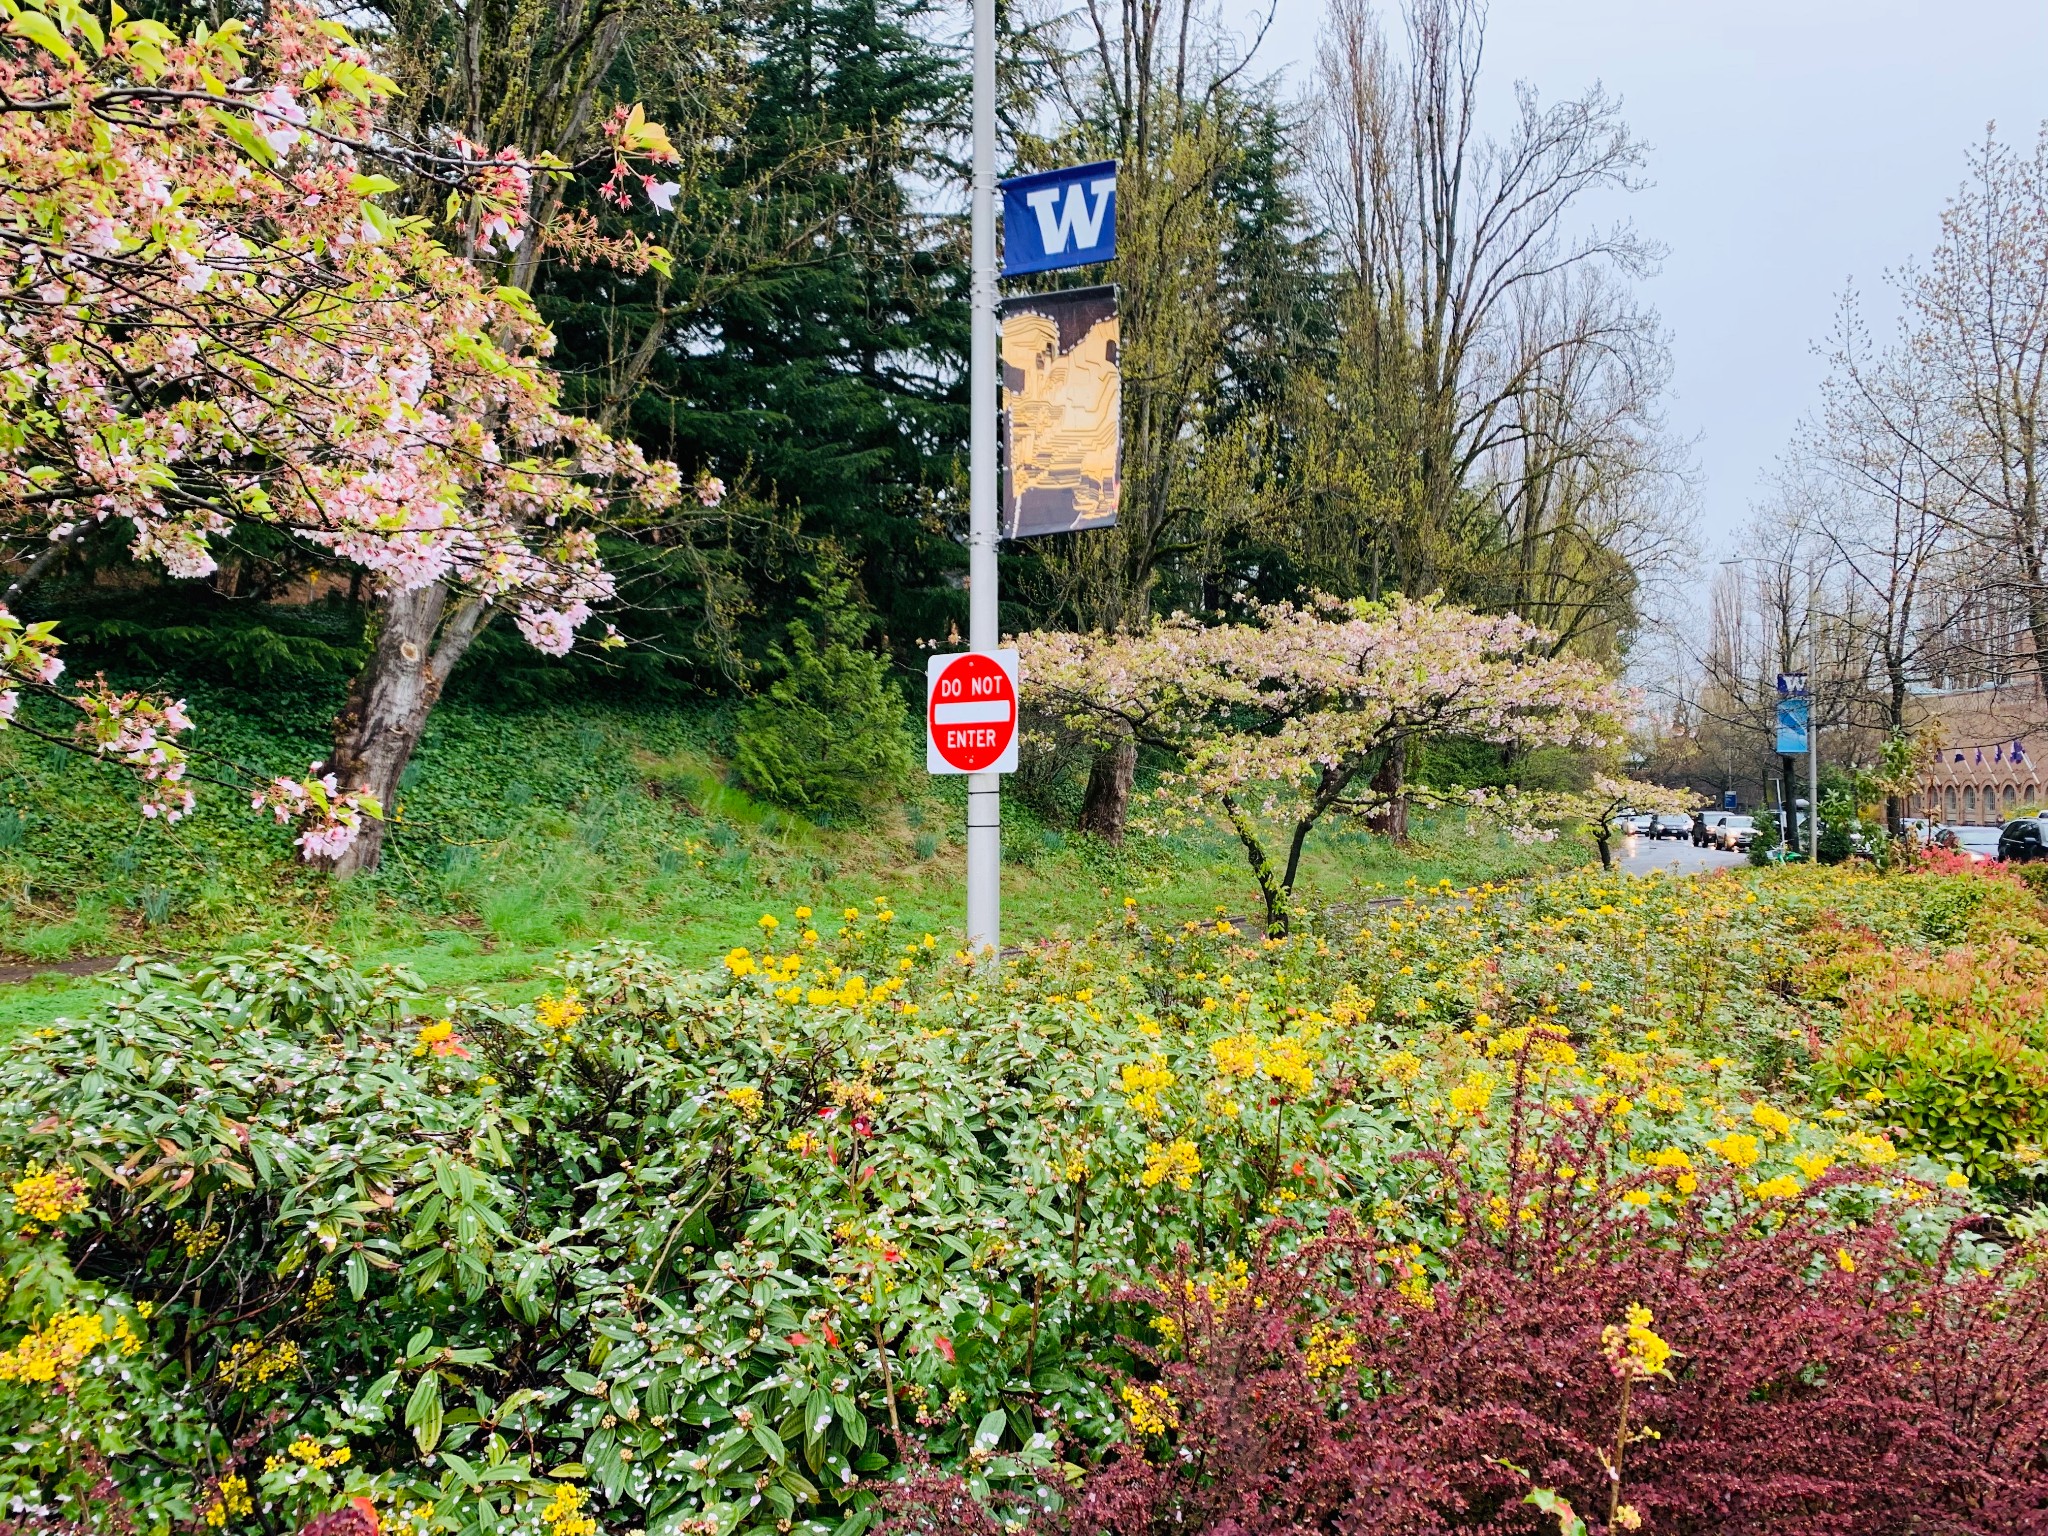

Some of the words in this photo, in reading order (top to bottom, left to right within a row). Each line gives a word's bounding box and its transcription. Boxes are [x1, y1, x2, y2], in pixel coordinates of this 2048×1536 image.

[1027, 178, 1116, 255] W
[942, 679, 961, 697] DO
[972, 676, 1002, 695] NOT
[1783, 676, 1807, 692] W
[947, 729, 996, 748] ENTER
